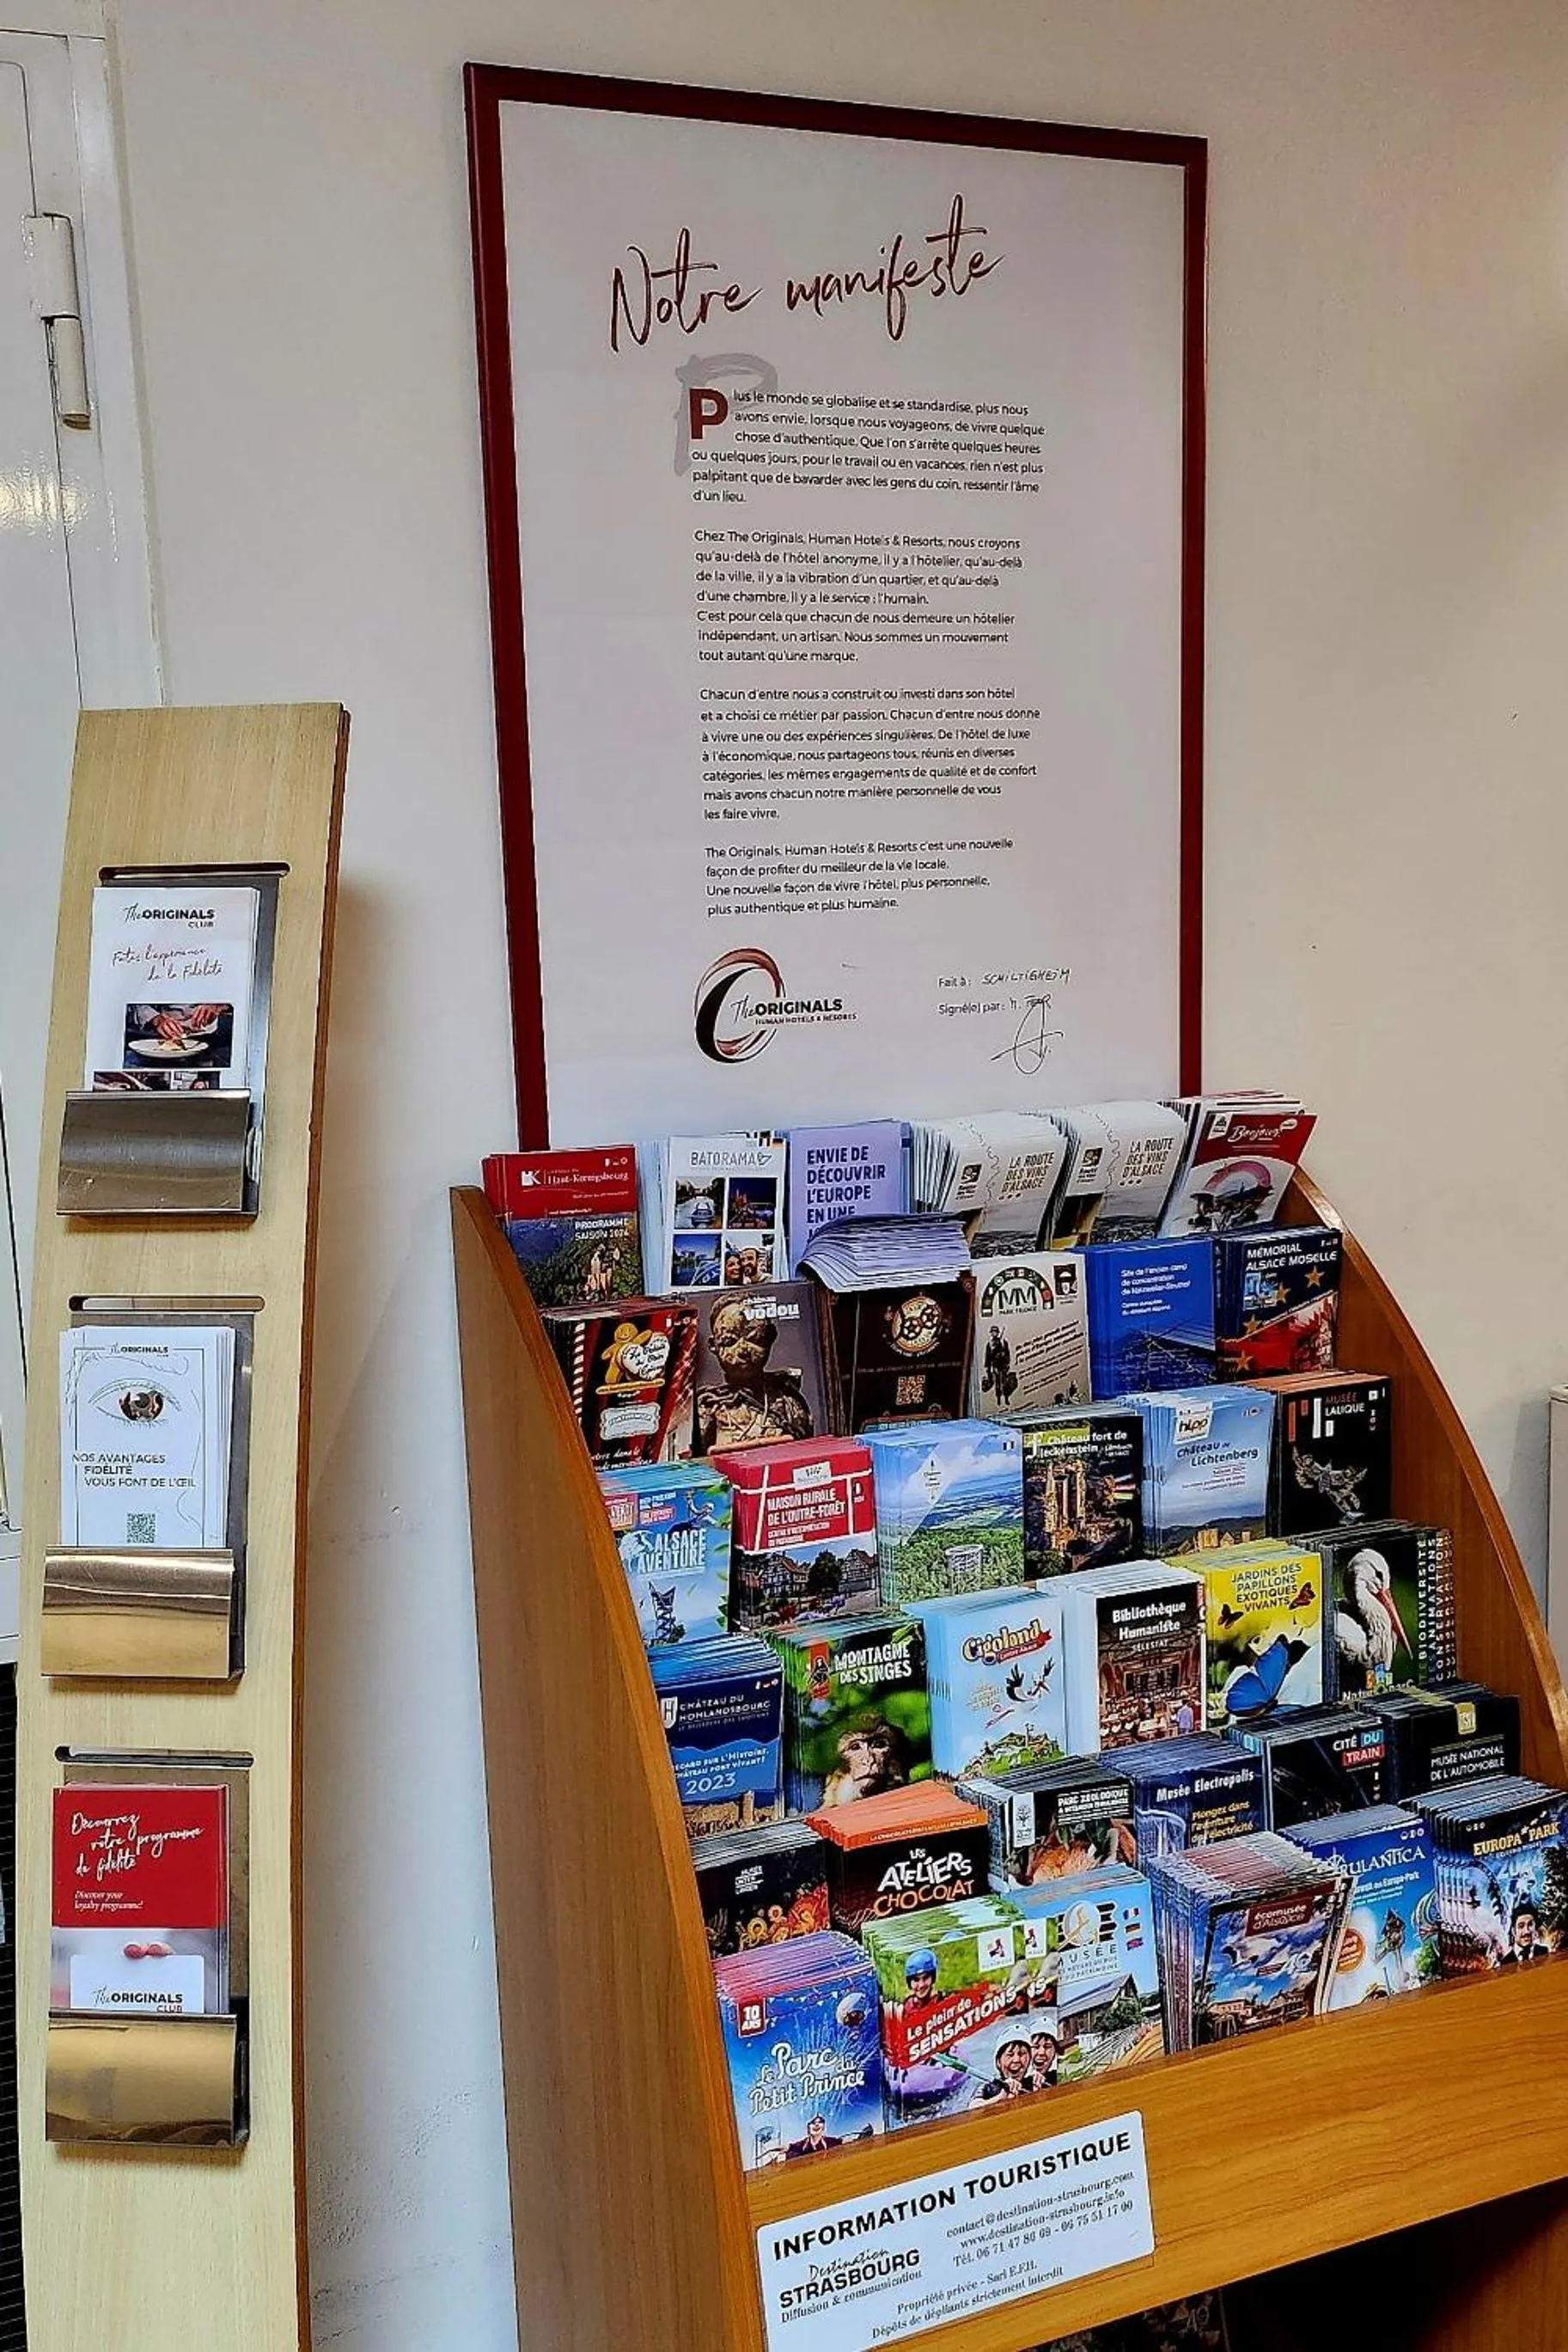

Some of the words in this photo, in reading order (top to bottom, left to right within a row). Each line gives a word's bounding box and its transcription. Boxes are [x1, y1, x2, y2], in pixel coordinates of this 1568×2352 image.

[612, 226, 762, 351] Notre
[785, 194, 1005, 340] manifeste
[734, 391, 752, 404] lus
[753, 391, 765, 404] le
[766, 389, 809, 405] monde
[811, 396, 824, 405] se
[826, 394, 877, 408] globalise
[878, 400, 894, 408] et
[891, 401, 906, 410] se
[906, 400, 974, 412] standardise,
[974, 403, 1000, 415] plus
[1001, 406, 1028, 416] nous
[735, 412, 770, 422] avons
[772, 412, 808, 425] envie,
[809, 415, 856, 430] lorsque
[857, 418, 887, 427] nous
[888, 420, 953, 434] voyageons,
[954, 420, 970, 431] de
[970, 422, 998, 433] vivre
[999, 424, 1046, 437] quelque
[735, 431, 771, 443] chose
[772, 433, 858, 449] d'authentique.
[859, 437, 884, 449] Que
[886, 437, 907, 449] l'on
[908, 438, 950, 450] s'arrête
[951, 441, 1003, 454] quelques
[1004, 442, 1041, 454] heures
[692, 490, 721, 501] d'un
[722, 491, 747, 502] lieu.
[699, 651, 724, 661] tout
[726, 651, 766, 661] autant
[767, 650, 808, 663] qu'une
[809, 653, 859, 663] marque.
[704, 809, 721, 820] les
[722, 808, 748, 819] faire
[749, 808, 780, 818] vivre.
[141, 908, 215, 919] ORIGINALS
[707, 904, 733, 918] plus
[734, 901, 805, 914] authentique
[807, 901, 820, 910] et
[821, 900, 846, 913] plus
[847, 897, 900, 909] humaine.
[754, 999, 843, 1016] ORIGINALS
[807, 1148, 848, 1164] ENVIE
[851, 1145, 869, 1161] DE
[1144, 1138, 1175, 1152] ROUTE
[691, 1152, 760, 1166] BATORAMA
[1126, 1152, 1145, 1166] DES
[1146, 1149, 1169, 1164] VINS
[807, 1164, 886, 1184] DÉCOUVRIR
[1121, 1163, 1165, 1178] D'ALSACE
[807, 1185, 871, 1204] L'EUROPE
[807, 1208, 825, 1224] EN
[1246, 1257, 1286, 1273] ALSACE
[1288, 1251, 1338, 1267] MOSELLE
[1247, 1243, 1303, 1259] MÉMORIAL
[1324, 1402, 1365, 1417] LALIQUE
[72, 1453, 95, 1463] NOS
[98, 1452, 166, 1463] AVANTAGES
[84, 1477, 116, 1488] VOUS
[118, 1477, 149, 1488] FONT
[150, 1477, 167, 1488] DE
[654, 1528, 707, 1552] ALSACE
[1231, 1566, 1278, 1584] JARDINS
[1281, 1562, 1303, 1575] DES
[1236, 1574, 1296, 1592] PAPILLONS
[1236, 1585, 1298, 1604] EXOTIQUES
[1244, 1597, 1290, 1614] VIVANTS
[1113, 1600, 1187, 1623] Bibliothèque
[961, 1616, 1042, 1665] Cigoland
[833, 1641, 912, 1672] MONTAGNE
[839, 1671, 858, 1685] DES
[858, 1659, 913, 1685] SINGES
[680, 1696, 727, 1712] CHÂTEAU
[729, 1694, 745, 1704] DU
[1333, 1735, 1358, 1752] CITÉ
[1362, 1730, 1381, 1745] DU
[1345, 1746, 1382, 1764] TRAIN
[1431, 1753, 1458, 1768] MUSÉE
[1460, 1745, 1504, 1761] NATIONAL
[1430, 1770, 1443, 1782] DE
[1444, 1757, 1505, 1781] L'AUTOMOBILE
[686, 1771, 736, 1796] 2023
[1156, 1782, 1191, 1803] Musée
[1193, 1767, 1254, 1793] Electropolis
[1528, 1821, 1561, 1842] PARK
[1339, 1845, 1427, 1877] RULANTICA
[873, 1879, 976, 1917] CHOCOLAT
[111, 1993, 184, 2004] ORIGINALS
[744, 2004, 761, 2021] 10
[906, 2025, 924, 2042] Le
[924, 2005, 955, 2037] plein
[956, 1996, 973, 2016] de
[741, 2017, 761, 2031] ANS
[907, 1987, 1017, 2063] SENSATIONS
[771, 2041, 839, 2081] Parc
[747, 2081, 798, 2117] Petit
[800, 2068, 866, 2101] Prince
[773, 2186, 955, 2261] INFORMATION
[963, 2131, 1132, 2200] TOURISTIQUE
[976, 2245, 990, 2261] 06
[992, 2241, 1004, 2255] 71
[1106, 2203, 1120, 2219] 17
[808, 2246, 889, 2282] Destination
[778, 2249, 920, 2309] STRASBOURG
[871, 2318, 908, 2339] Dépôts
[908, 2313, 923, 2327] de
[923, 2299, 971, 2323] dépliants
[971, 2278, 1027, 2306] strictement
[1027, 2265, 1065, 2289] interdit
[897, 2292, 945, 2315] Propriété
[945, 2280, 979, 2302] privée
[781, 2299, 830, 2324] Diffusion
